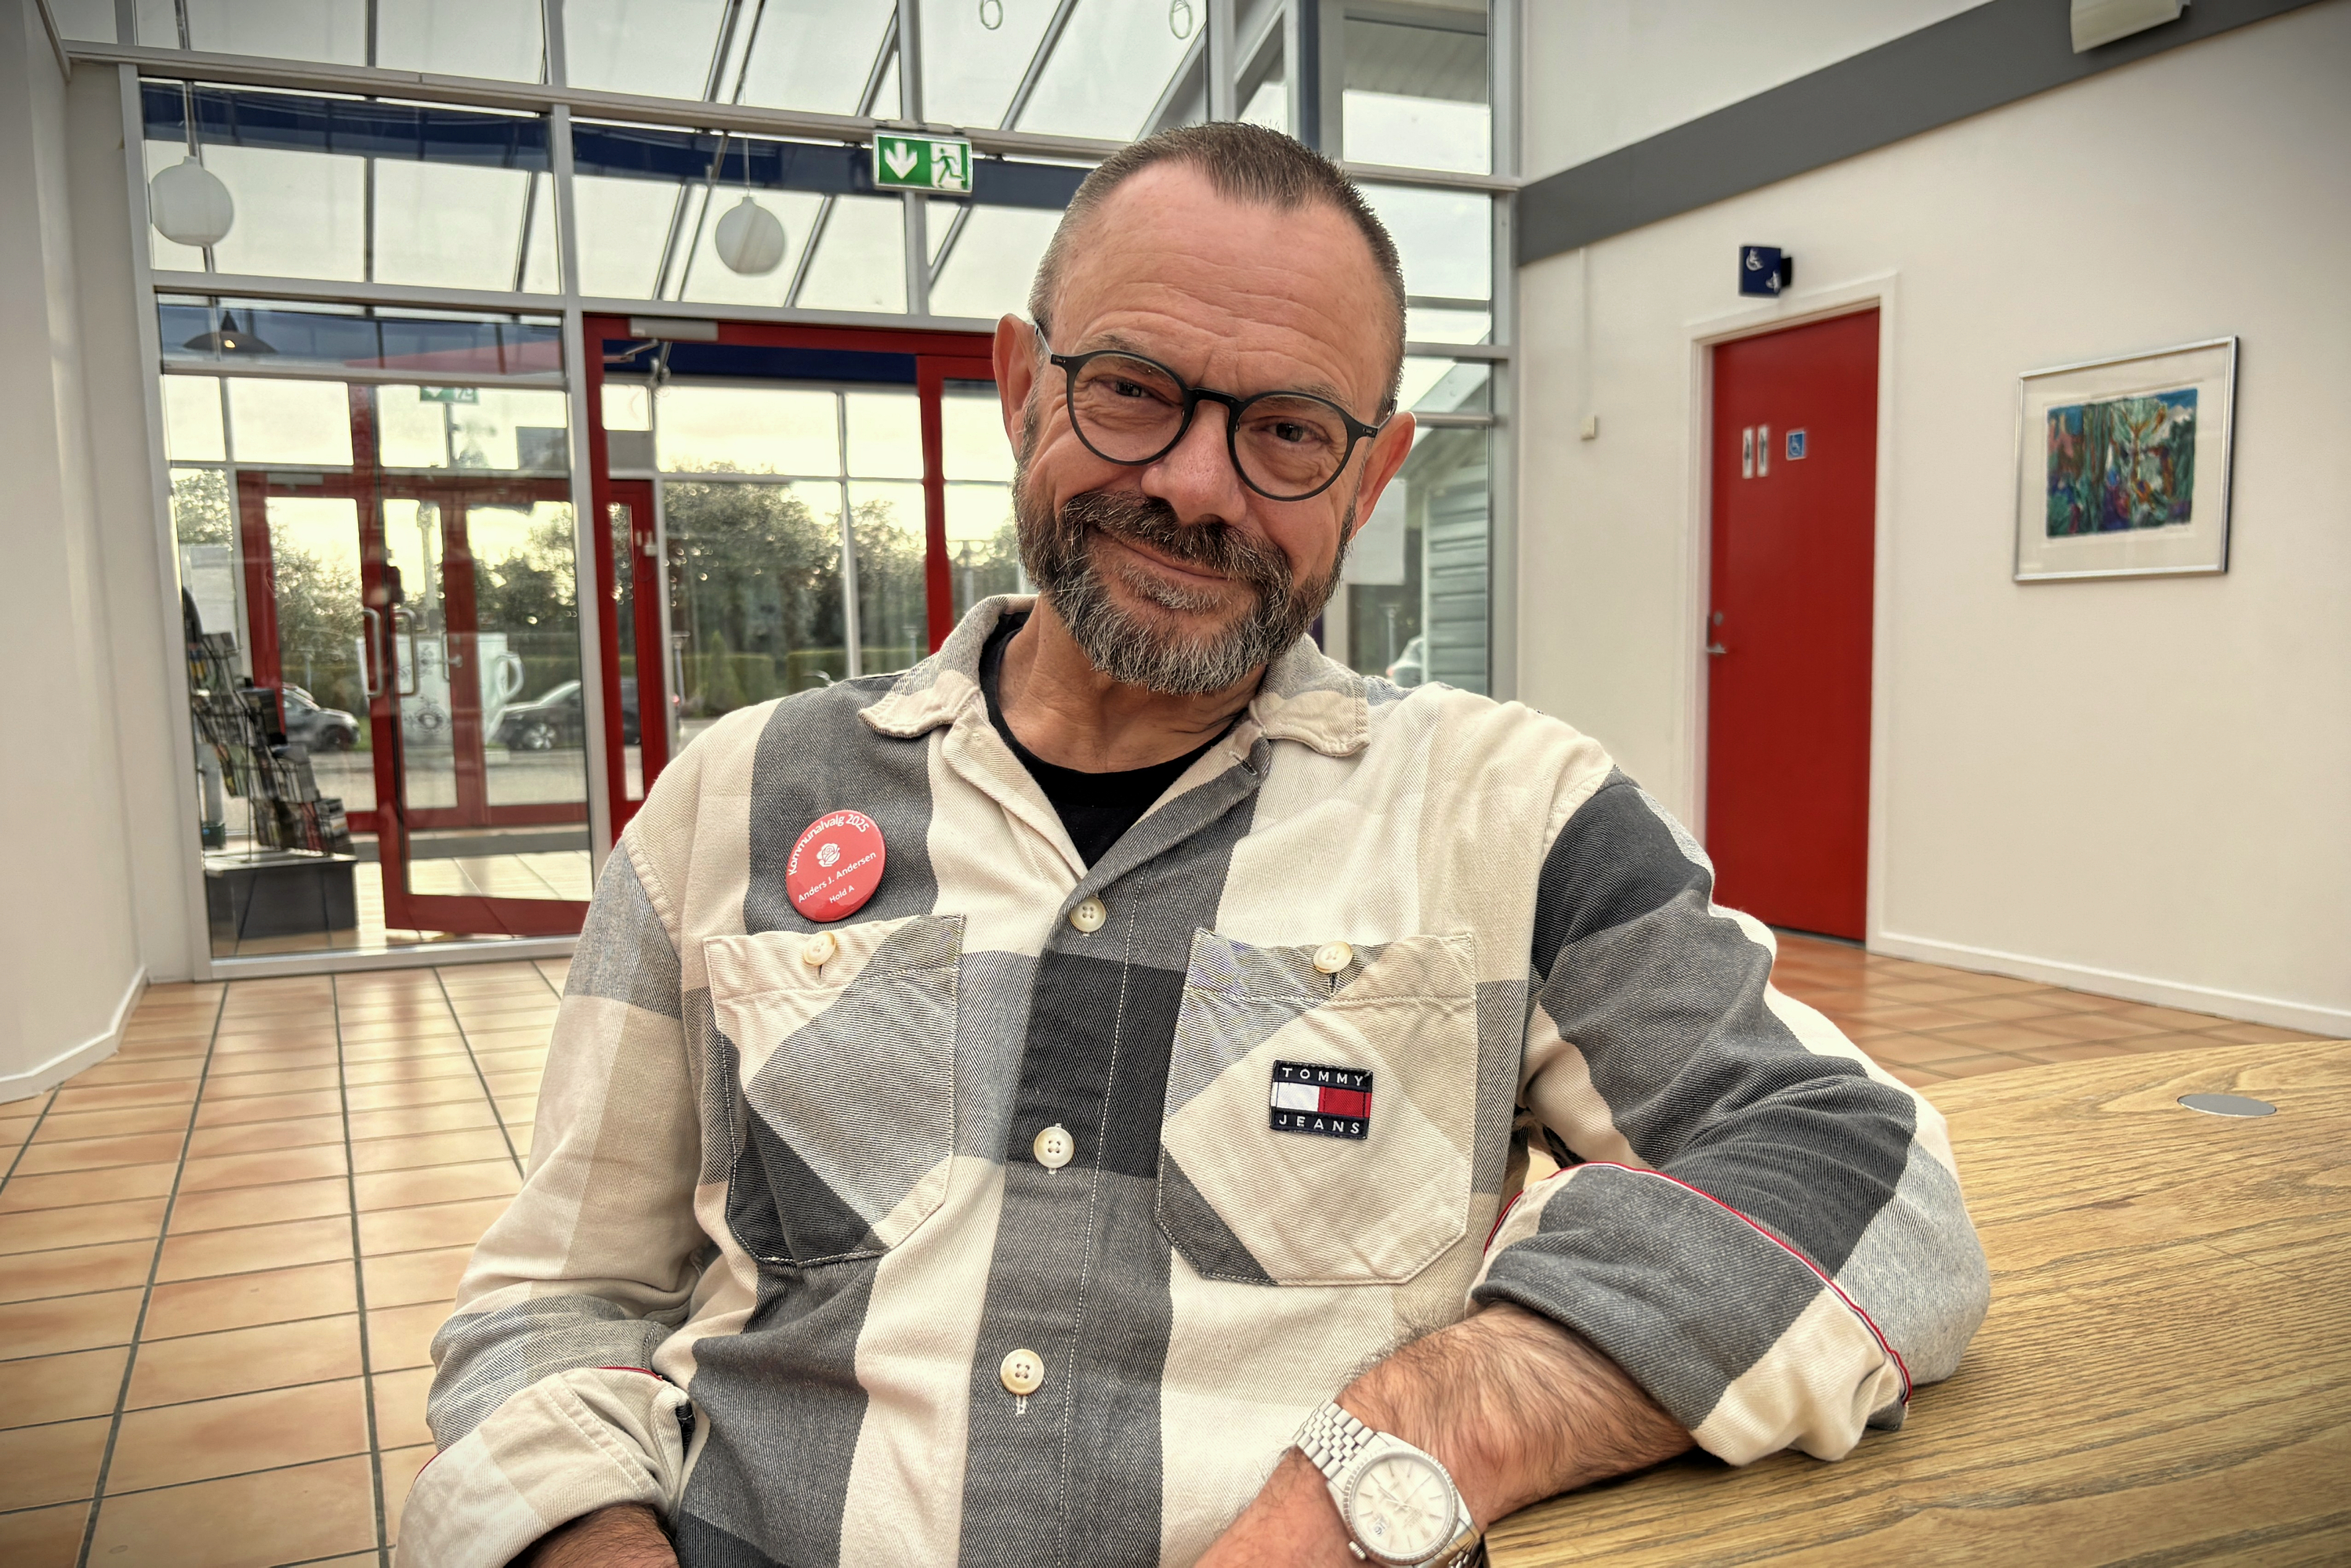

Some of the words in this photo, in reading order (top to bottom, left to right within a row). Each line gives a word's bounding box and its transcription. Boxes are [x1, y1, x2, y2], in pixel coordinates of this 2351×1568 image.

[788, 814, 845, 875] Kommunalvalg
[846, 814, 869, 832] 2025
[799, 881, 827, 903] Anders
[836, 852, 876, 879] Andersen
[829, 889, 847, 904] Hold
[1282, 1067, 1364, 1086] TOMMY
[1278, 1114, 1360, 1134] JEANS
